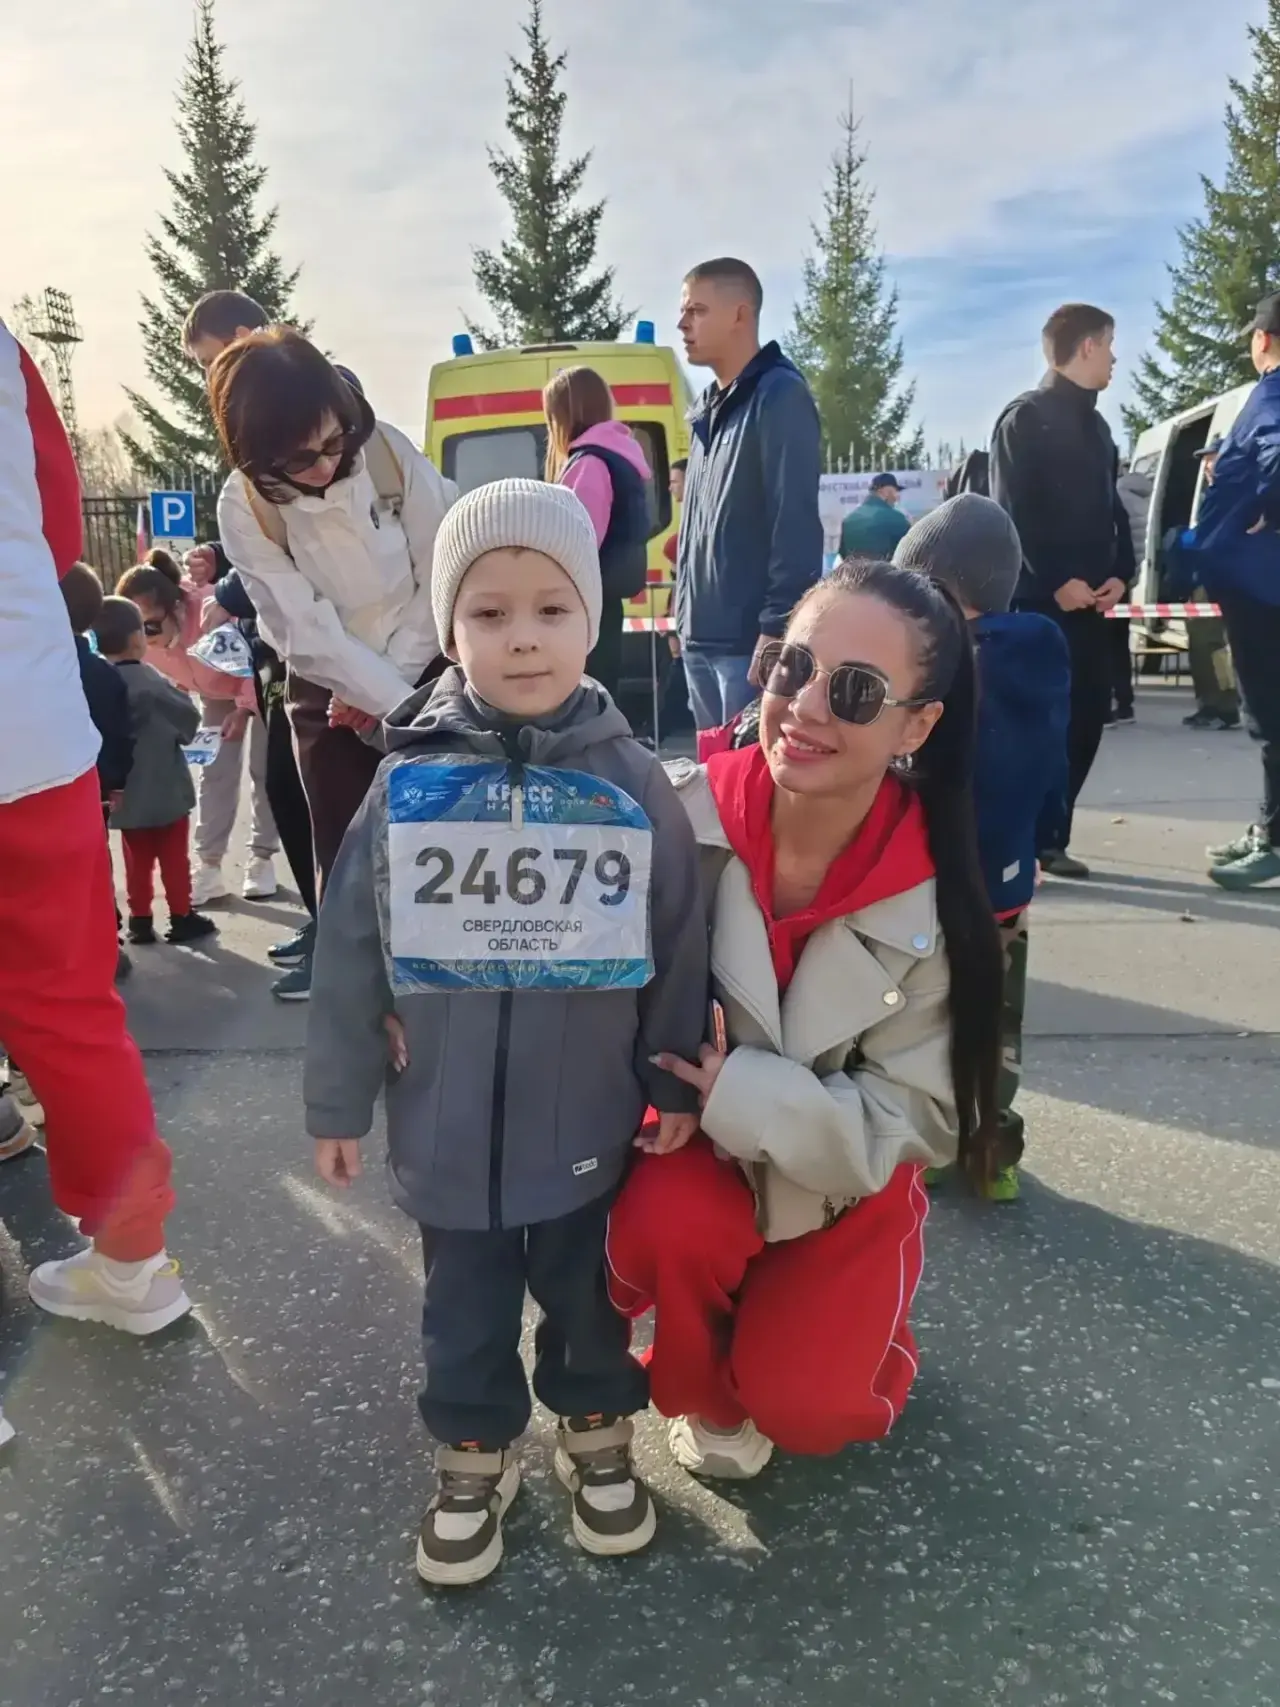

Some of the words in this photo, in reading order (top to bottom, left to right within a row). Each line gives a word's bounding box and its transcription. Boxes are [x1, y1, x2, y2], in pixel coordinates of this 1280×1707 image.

[162, 496, 186, 532] P
[487, 783, 553, 804] КРСС
[486, 802, 554, 813] НАИИ
[414, 846, 632, 906] 24679
[462, 919, 583, 934] СВЕРДЛОВСКАЯ
[487, 938, 559, 951] ОБЛАСТЬ
